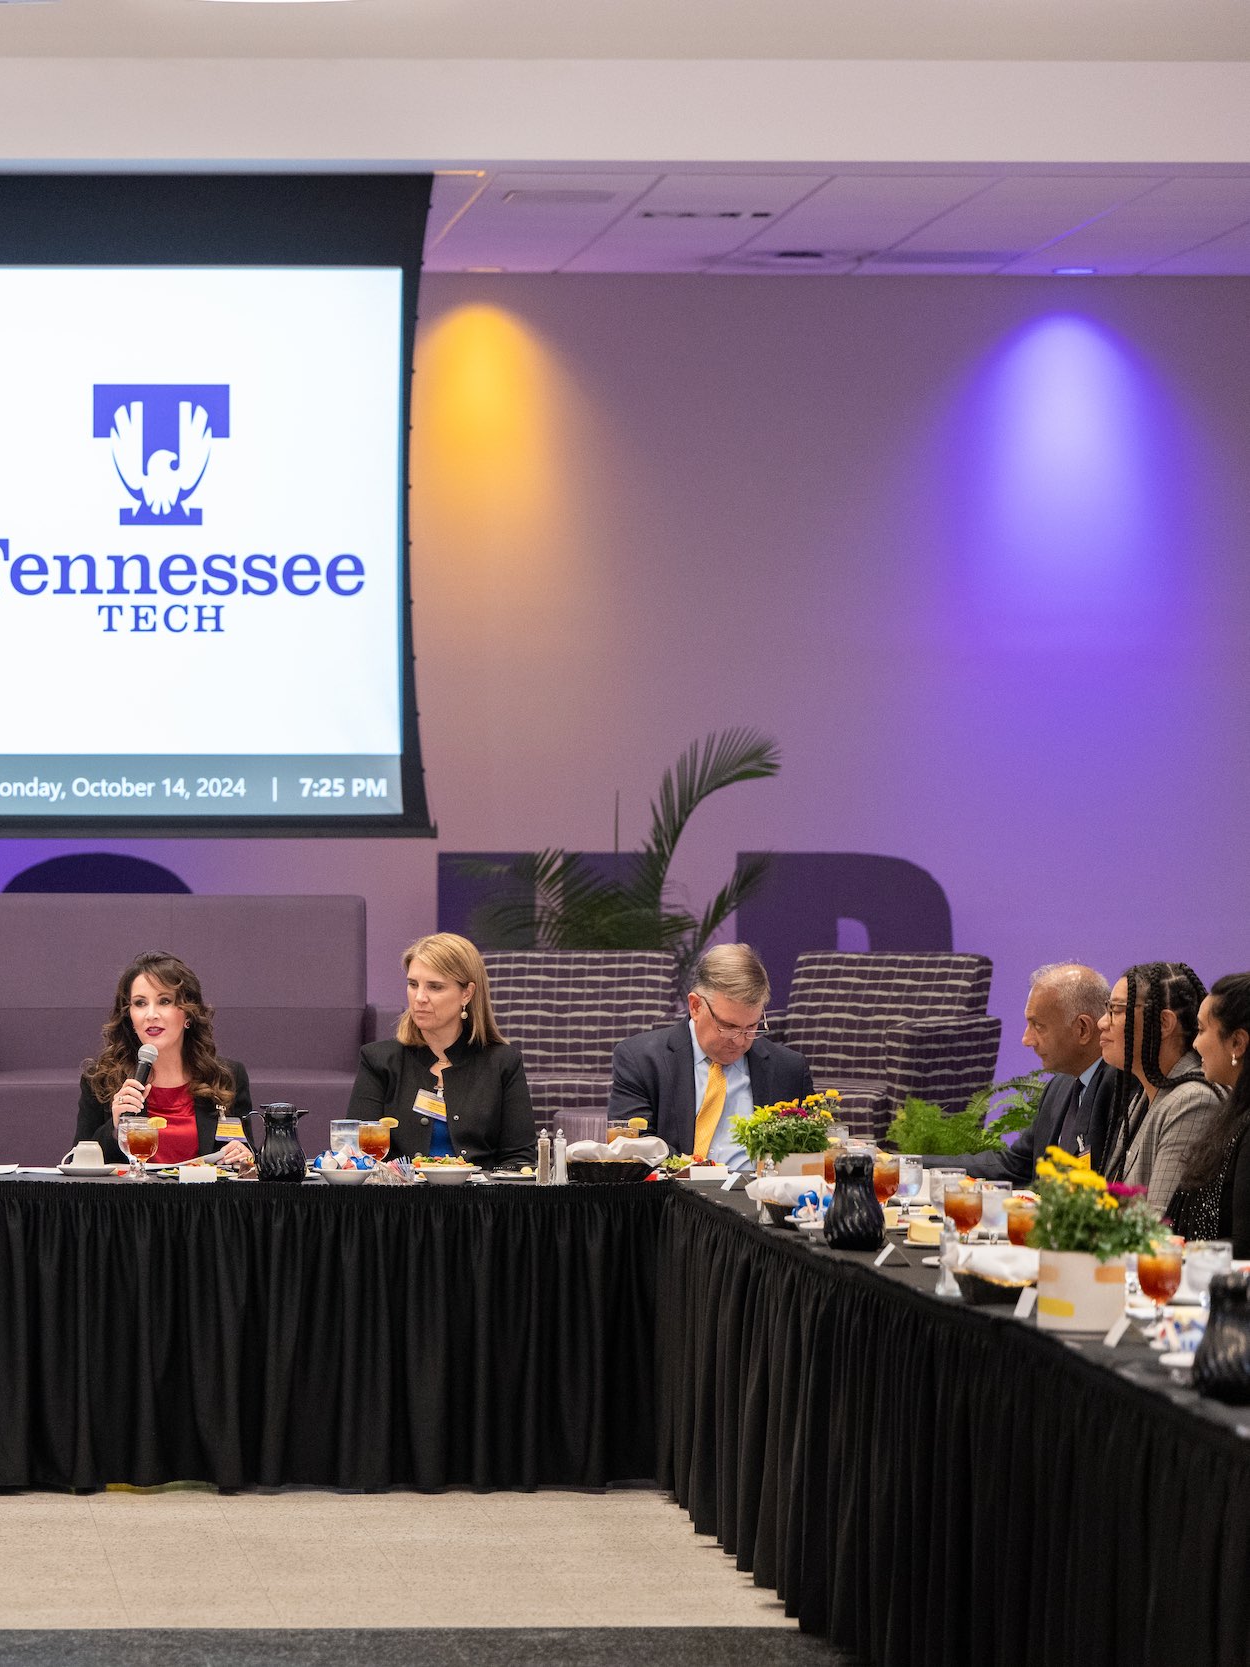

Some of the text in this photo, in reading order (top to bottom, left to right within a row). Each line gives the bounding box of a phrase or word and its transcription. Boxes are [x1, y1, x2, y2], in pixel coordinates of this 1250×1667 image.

[97, 604, 225, 634] TECH
[72, 777, 154, 798] October
[161, 778, 190, 801] 14,
[196, 778, 246, 798] 2024
[299, 778, 345, 798] 7:25
[352, 778, 388, 798] PM
